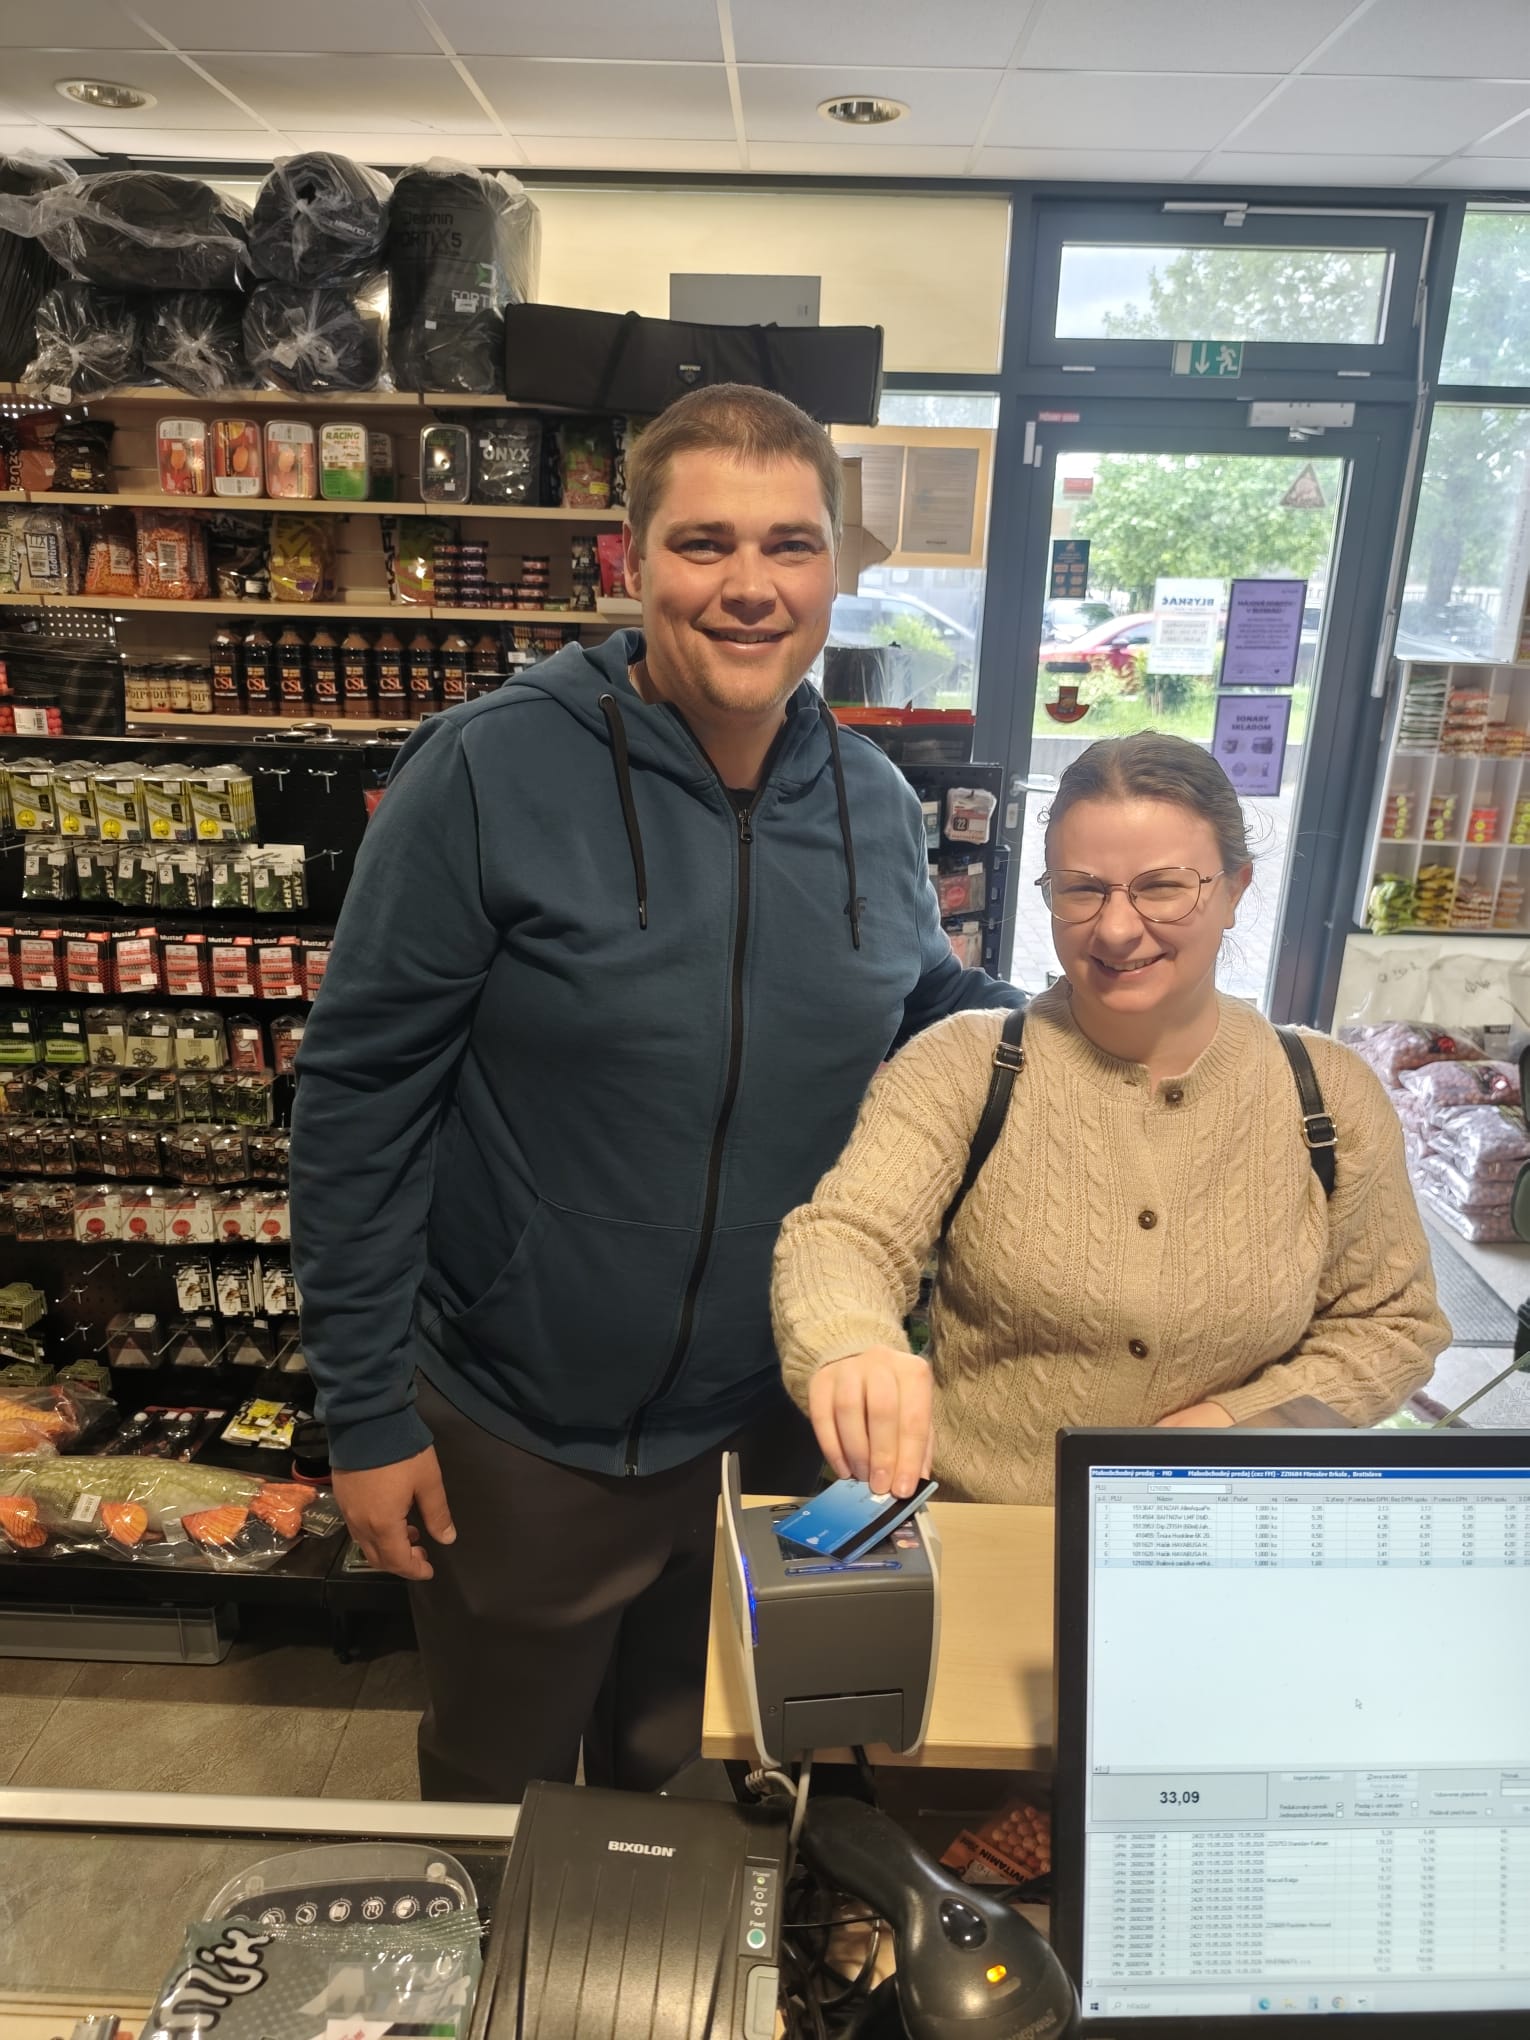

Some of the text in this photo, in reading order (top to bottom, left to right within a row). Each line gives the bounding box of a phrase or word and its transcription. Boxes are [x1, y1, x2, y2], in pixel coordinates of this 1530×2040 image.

[326, 431, 360, 441] RACING
[483, 447, 530, 462] ONYX
[214, 678, 236, 690] CSL
[247, 678, 269, 691] CSL
[281, 680, 304, 692] CSL
[316, 681, 338, 695] CSL
[345, 678, 368, 690] CSL
[379, 678, 403, 691] CSL
[411, 679, 433, 691] CSL
[15, 929, 39, 938] Mustad
[111, 930, 136, 938] Mustad
[160, 934, 184, 942] Mustad
[207, 936, 233, 944] Mustad
[253, 937, 278, 945] Mustad
[302, 939, 328, 948] Mustad
[1159, 1791, 1200, 1806] 33,09
[607, 1840, 674, 1858] BIXOLON
[752, 1870, 771, 1878] Power
[749, 1920, 767, 1928] Feed
